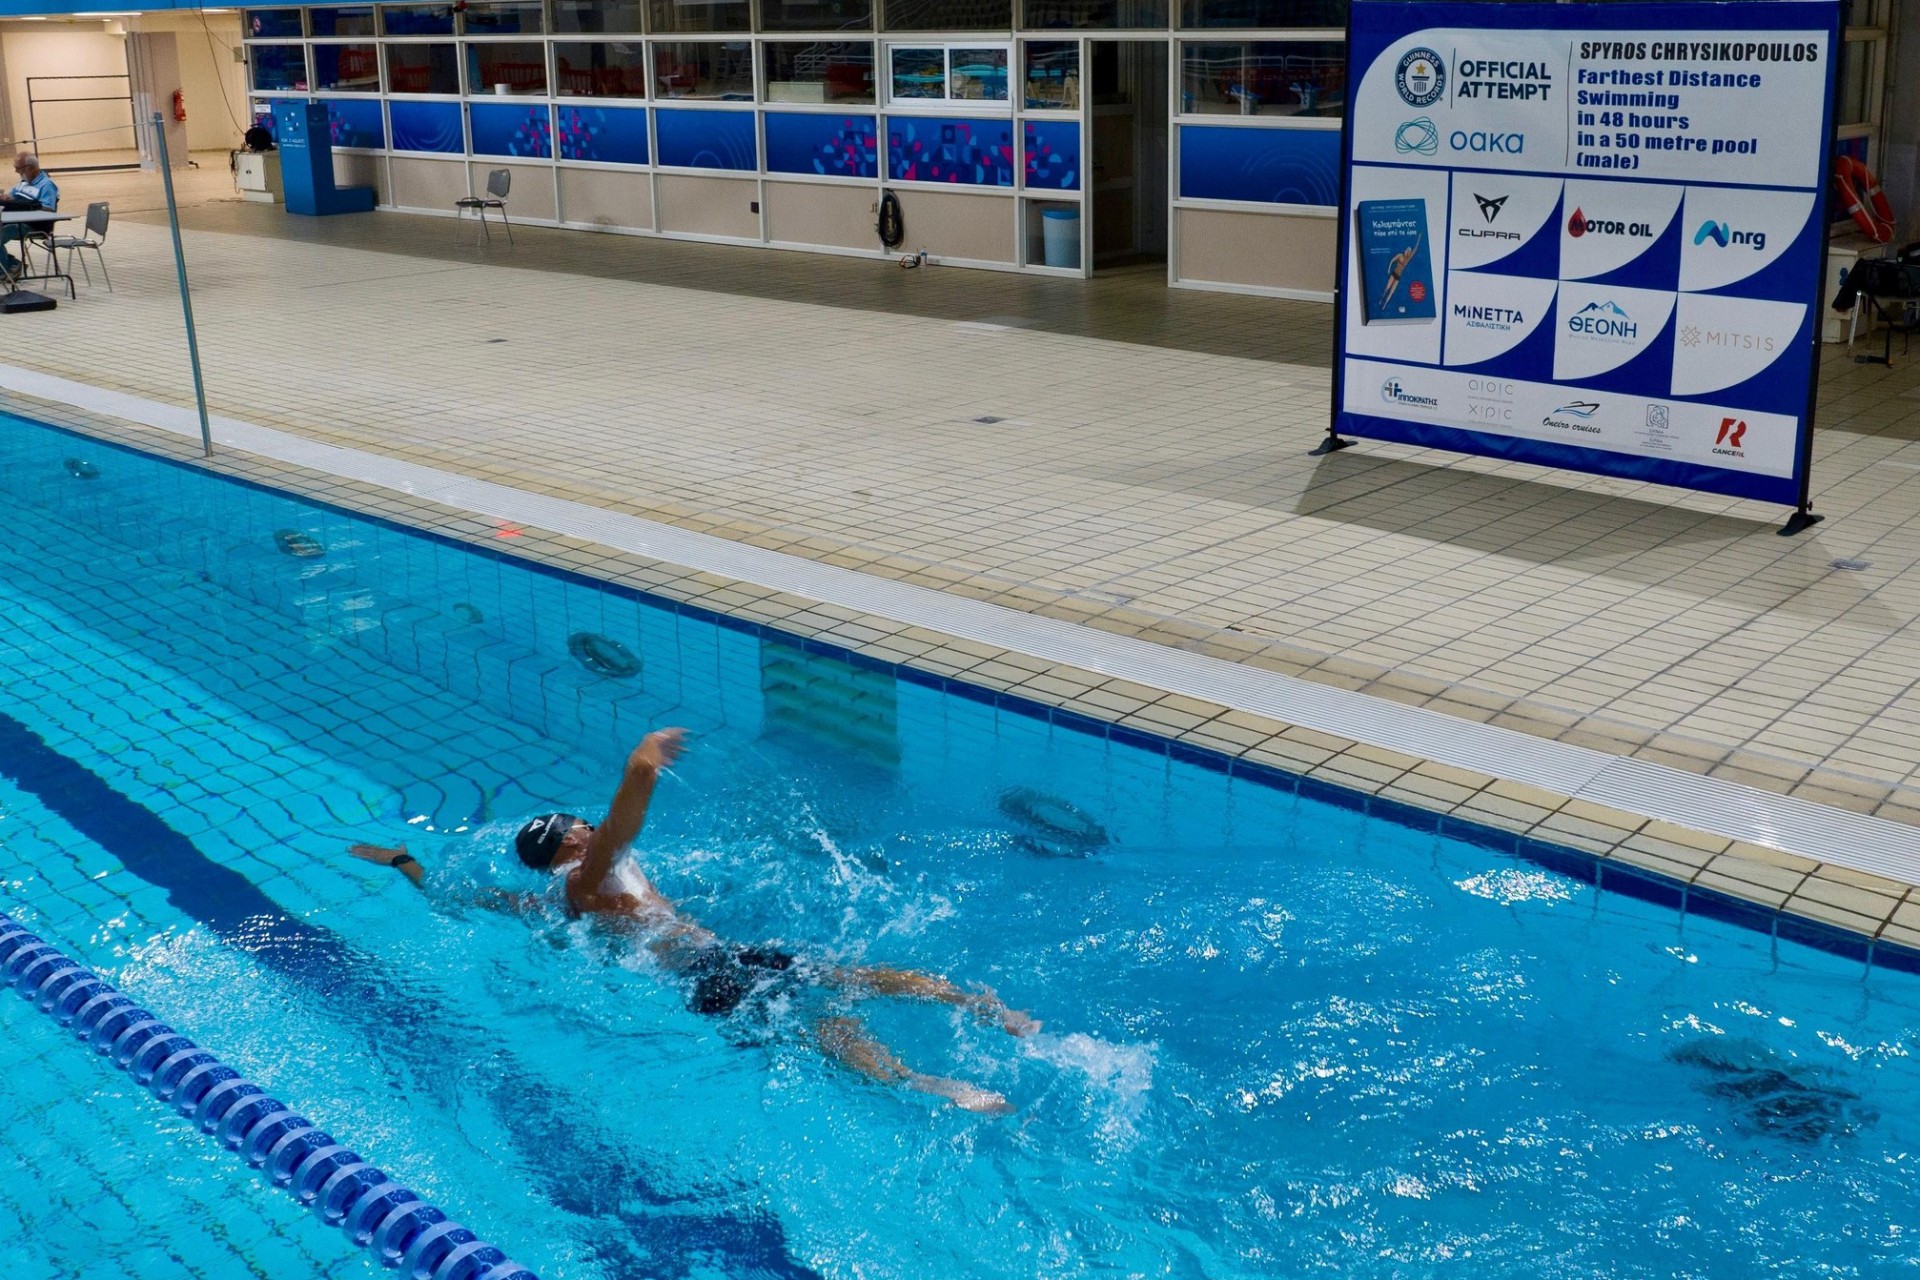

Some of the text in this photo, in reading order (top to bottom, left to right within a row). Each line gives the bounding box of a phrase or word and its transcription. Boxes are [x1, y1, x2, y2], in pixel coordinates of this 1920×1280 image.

[1403, 51, 1440, 67] GUINNESS
[1580, 42, 1818, 62] SPYROS CHRYSIKOPOULOS
[1459, 60, 1552, 80] OFFICIAL
[1577, 69, 1761, 87] Farthest Distance
[1398, 73, 1443, 104] WORLD RECORDS
[1458, 81, 1551, 101] ATTEMPT
[1577, 90, 1680, 109] Swimming
[1577, 111, 1690, 129] in 48 hours
[1577, 131, 1757, 154] in a 50 metre pool
[1576, 152, 1639, 170] (male)
[1458, 228, 1521, 241] CUPRA
[1570, 220, 1653, 238] MOTOR OIL
[1732, 231, 1766, 251] nrg
[1706, 331, 1774, 352] MITSIS
[1572, 423, 1601, 434] cruises
